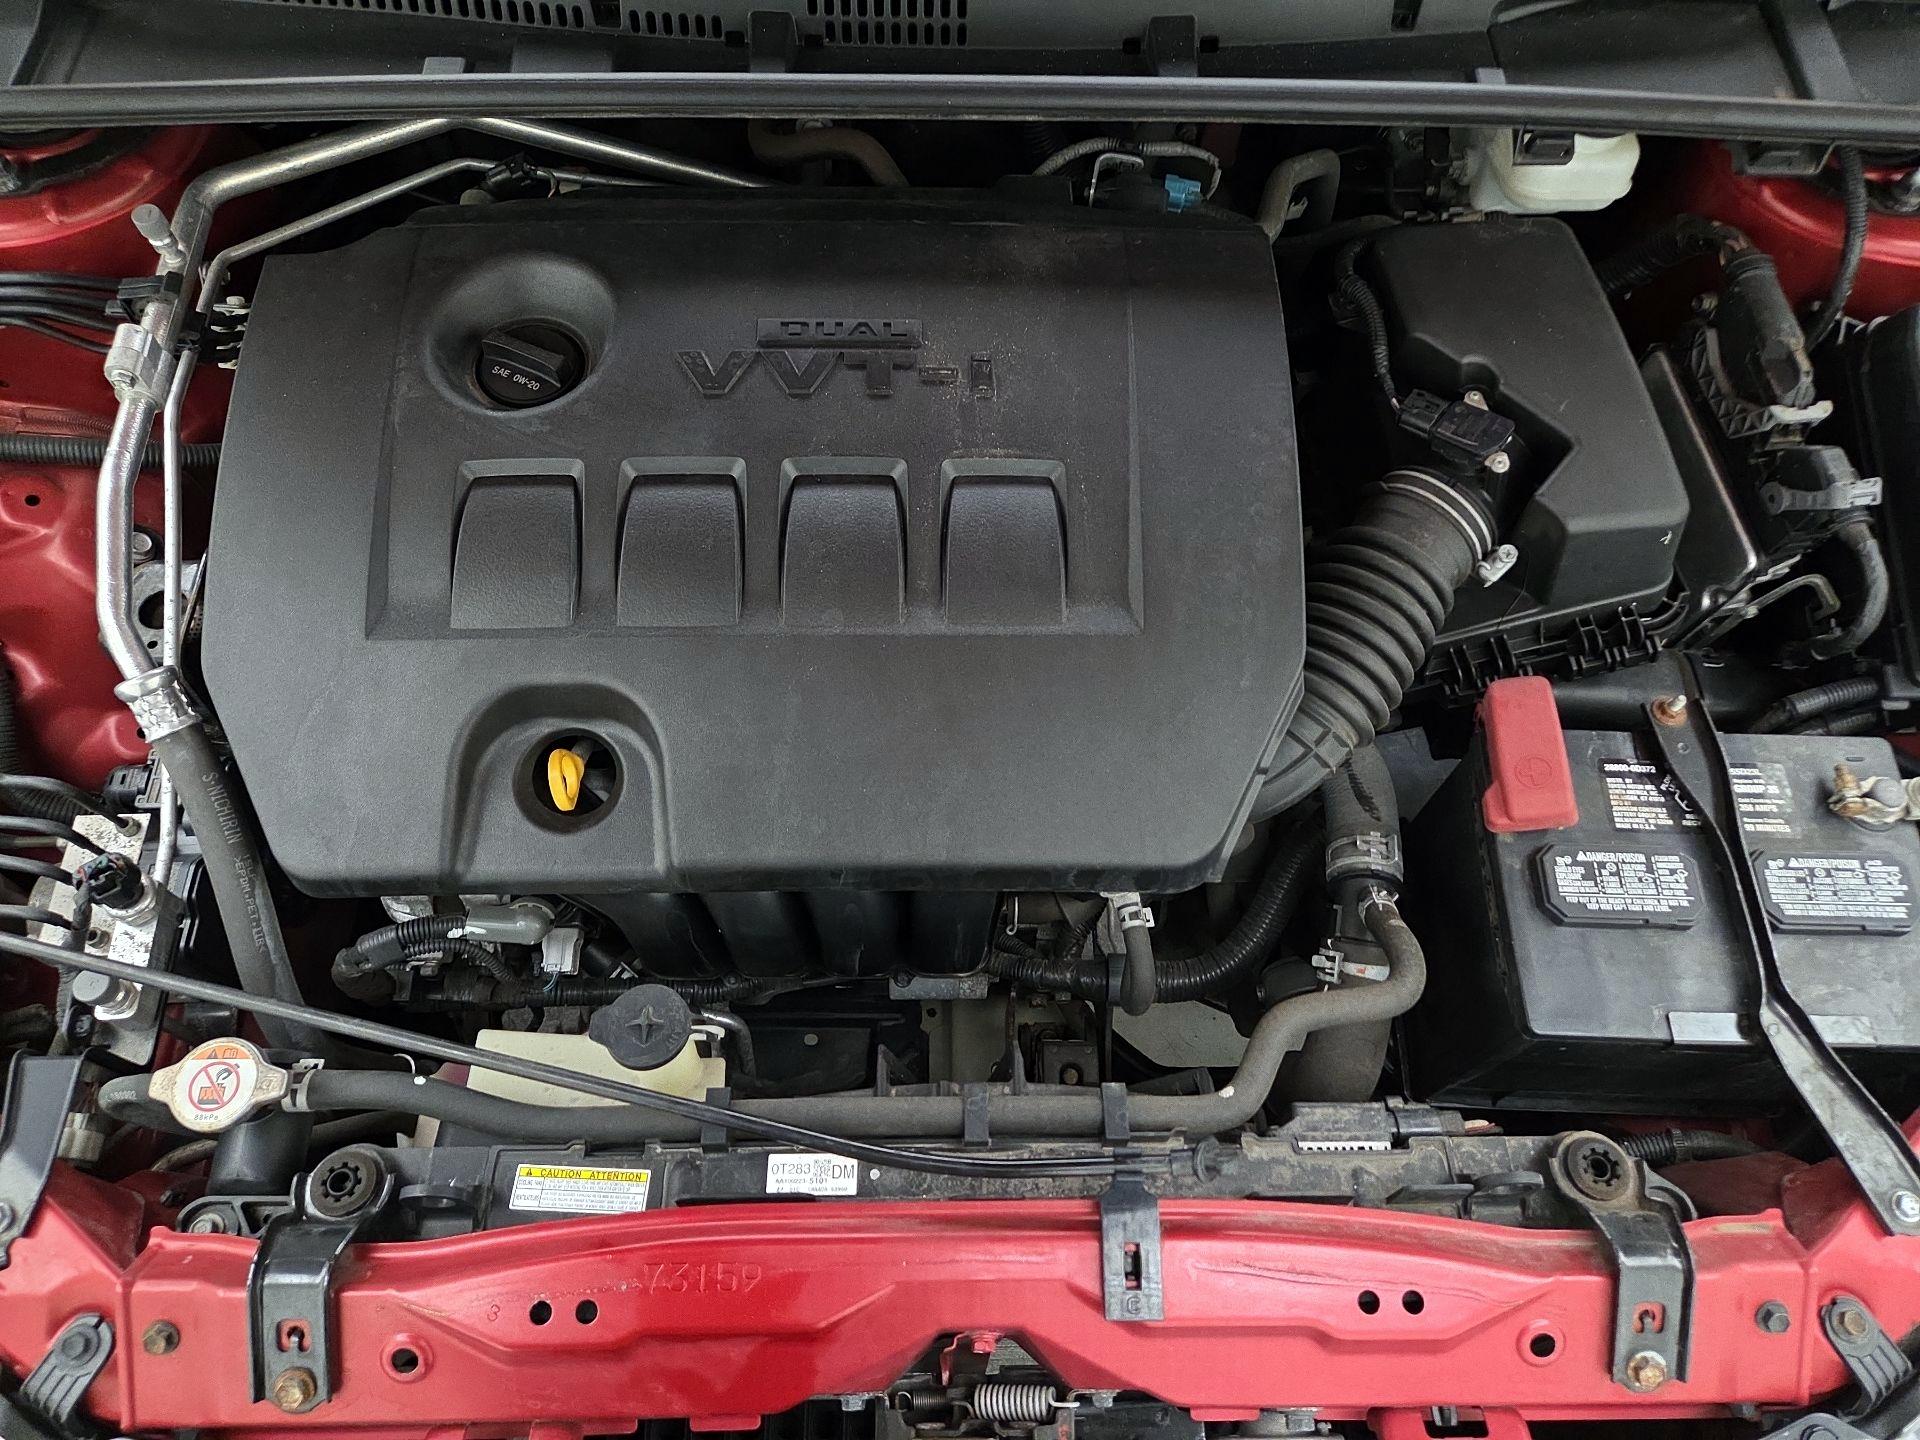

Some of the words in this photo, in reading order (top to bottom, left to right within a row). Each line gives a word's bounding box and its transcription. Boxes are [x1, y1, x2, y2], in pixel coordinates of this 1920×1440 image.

[780, 321, 908, 337] DUAL
[491, 365, 512, 379] SAE
[513, 374, 541, 392] 0W-20
[540, 1168, 582, 1179] CAUTION
[590, 1170, 642, 1182] ATTENTION
[832, 1164, 855, 1179] DM
[643, 1262, 762, 1295] 73159
